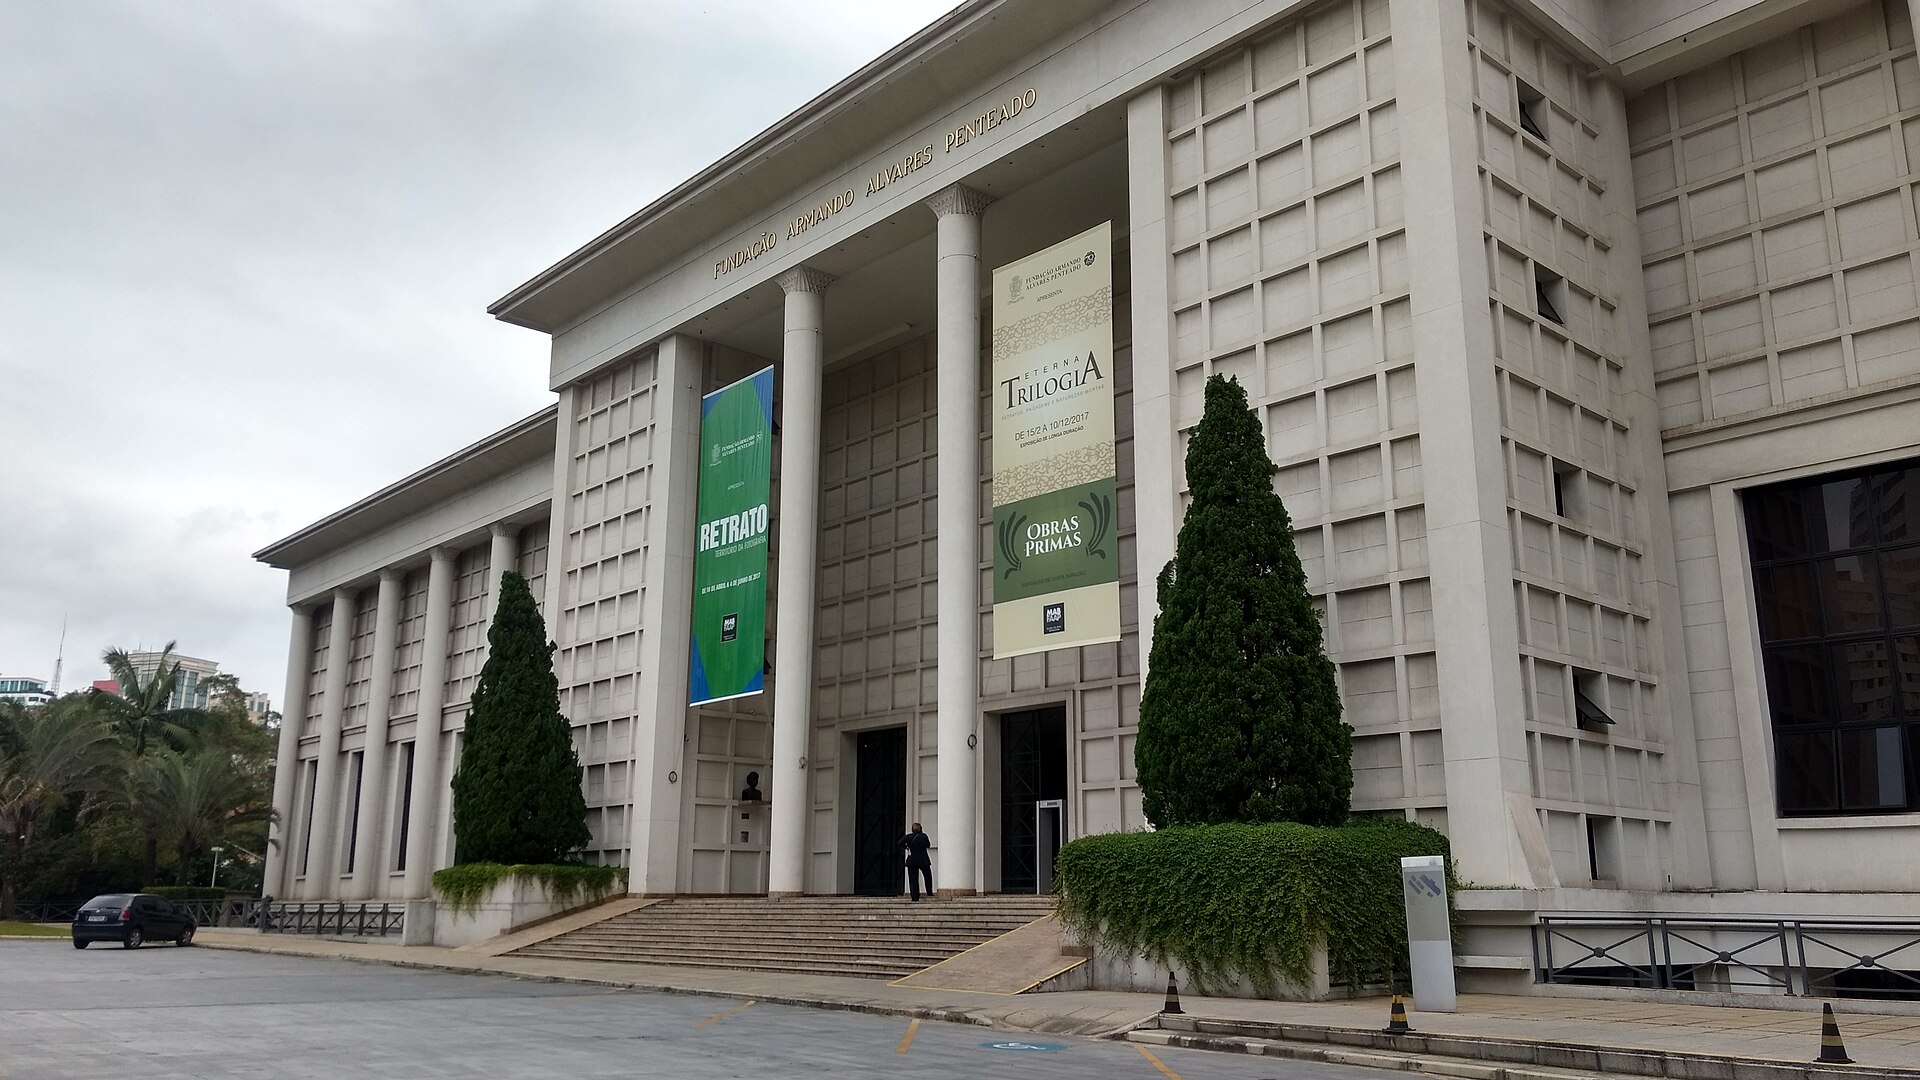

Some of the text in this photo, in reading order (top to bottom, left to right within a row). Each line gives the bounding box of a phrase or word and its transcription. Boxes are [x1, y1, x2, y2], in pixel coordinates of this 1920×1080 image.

[713, 88, 1037, 279] FUNDAÇÃO ARMANDO ALVARES PENTEADO
[1025, 257, 1081, 284] FUNDAÇÃO ARMANDO
[1025, 264, 1081, 291] ALVARES PENTEADO
[1036, 289, 1063, 303] APRESENTA
[1000, 350, 1105, 410] TRILOGIA
[1024, 355, 1080, 380] ETERNA
[1015, 411, 1089, 441] DE 15/2 A 10/12/2017
[1020, 436, 1042, 449] EXPOSIÇÃO
[1048, 432, 1063, 440] LONGA
[1063, 425, 1084, 436] DURAÇÃO
[700, 503, 768, 552] RETRATO
[1026, 515, 1080, 540] OBRAS
[1025, 531, 1082, 557] PRIMAS
[1046, 607, 1061, 616] MAB
